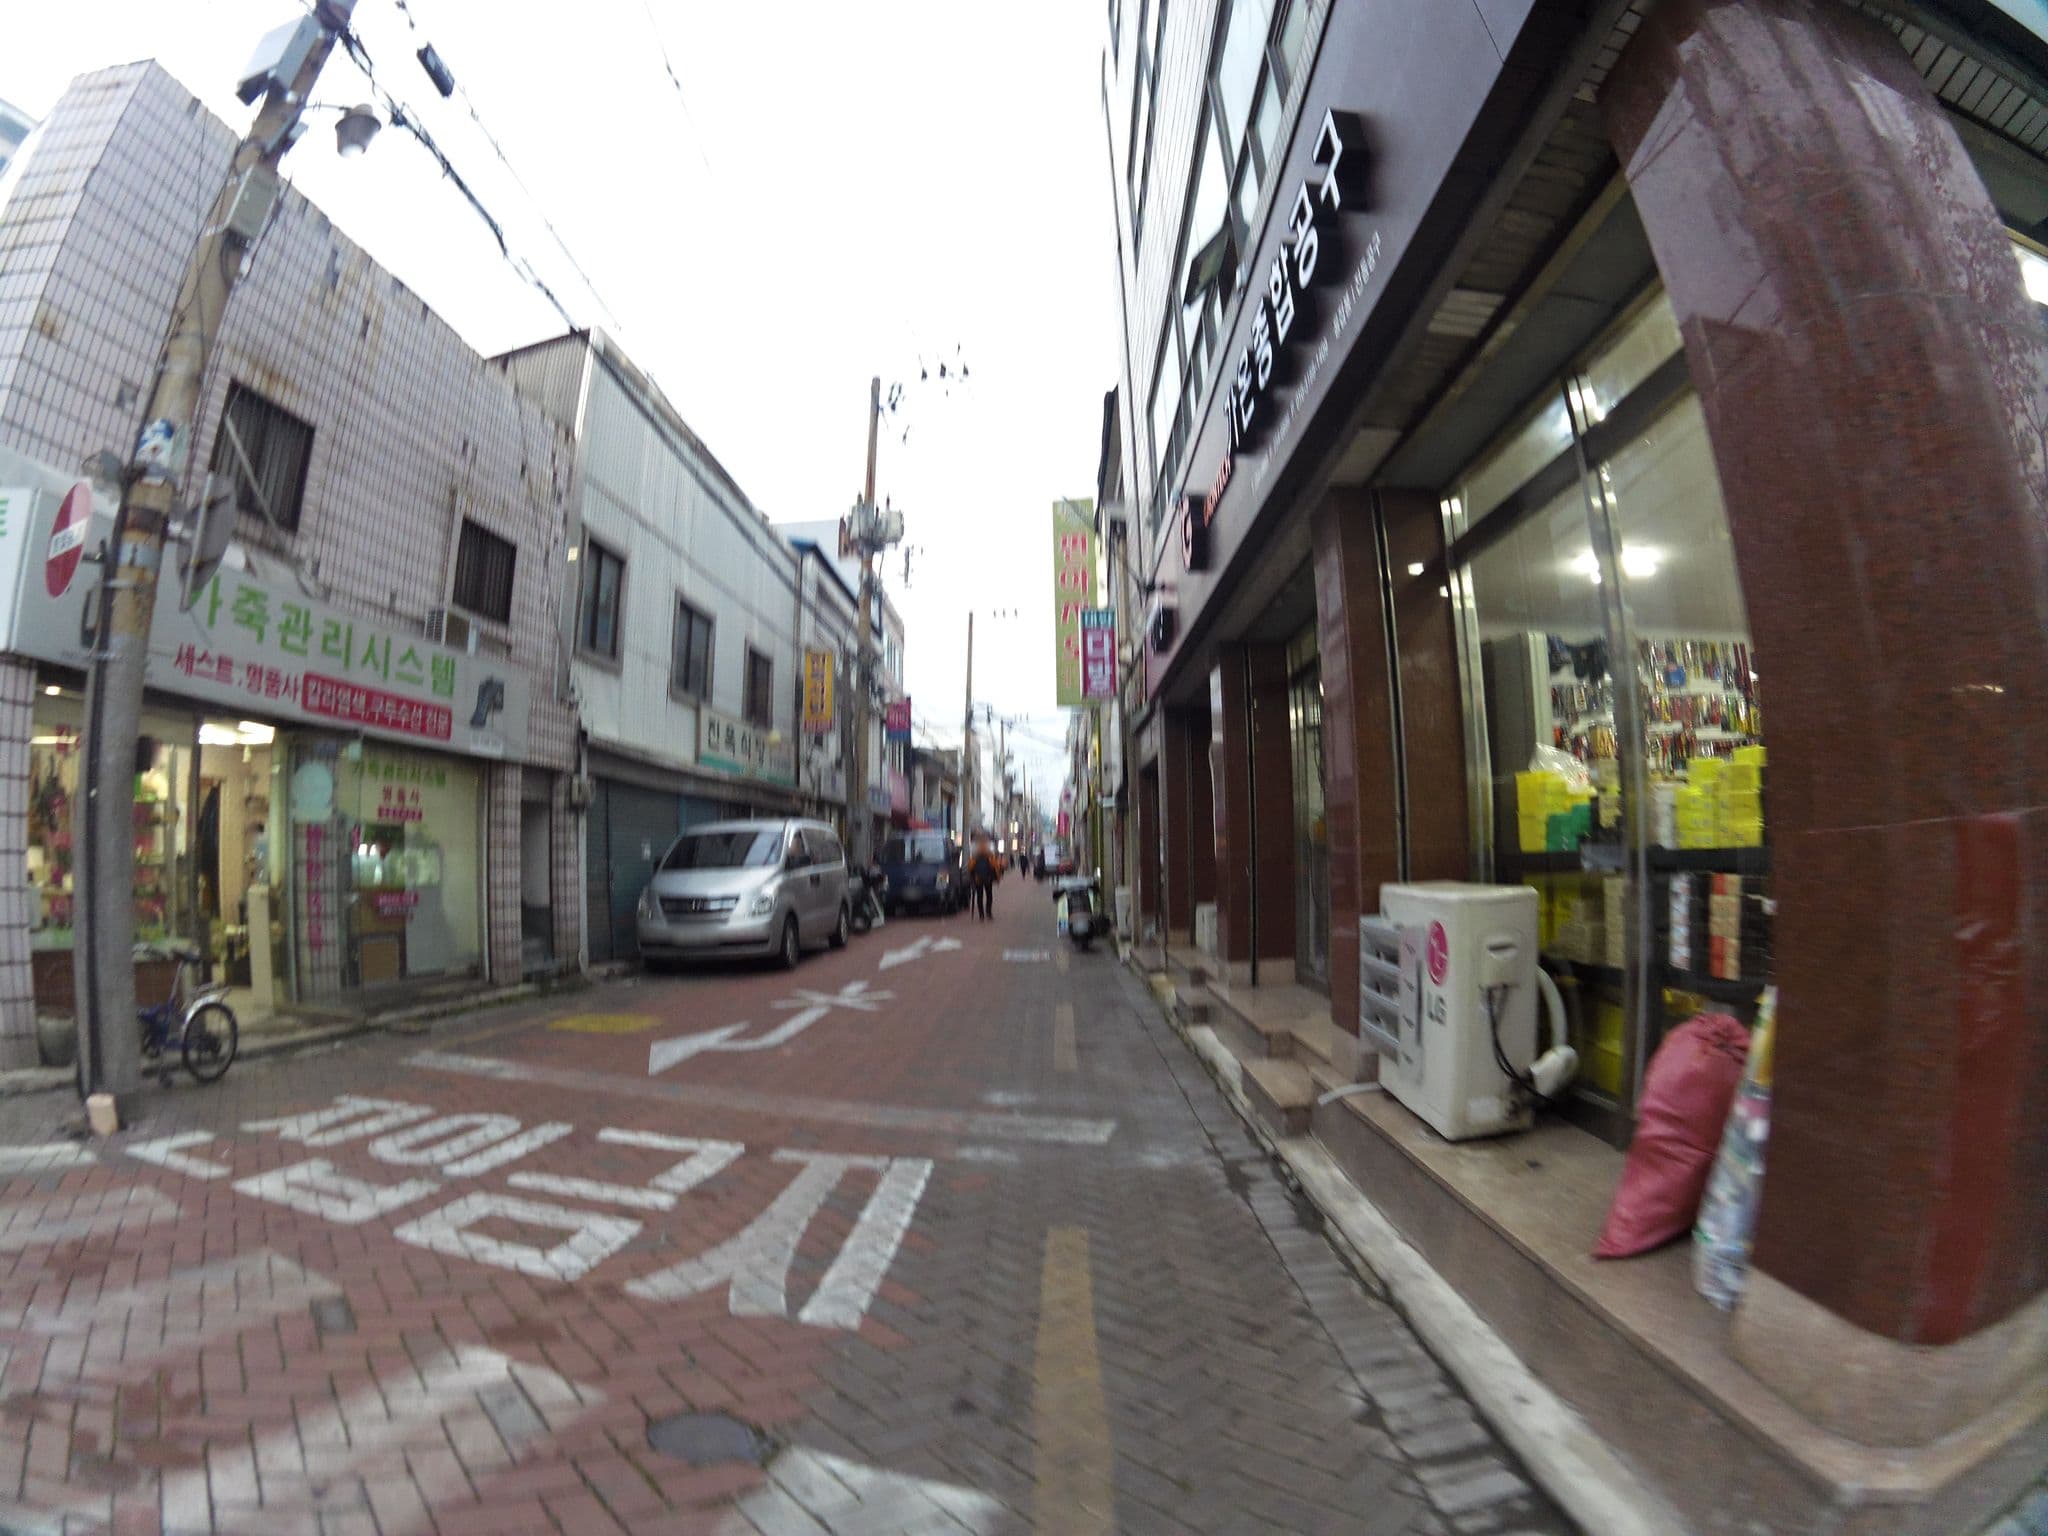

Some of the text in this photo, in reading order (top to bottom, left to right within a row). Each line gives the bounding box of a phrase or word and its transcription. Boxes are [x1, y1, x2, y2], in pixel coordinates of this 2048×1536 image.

[1224, 106, 1343, 457] 가온종합공구
[189, 574, 456, 697] 가죽관리시스템
[1427, 991, 1447, 1025] LG
